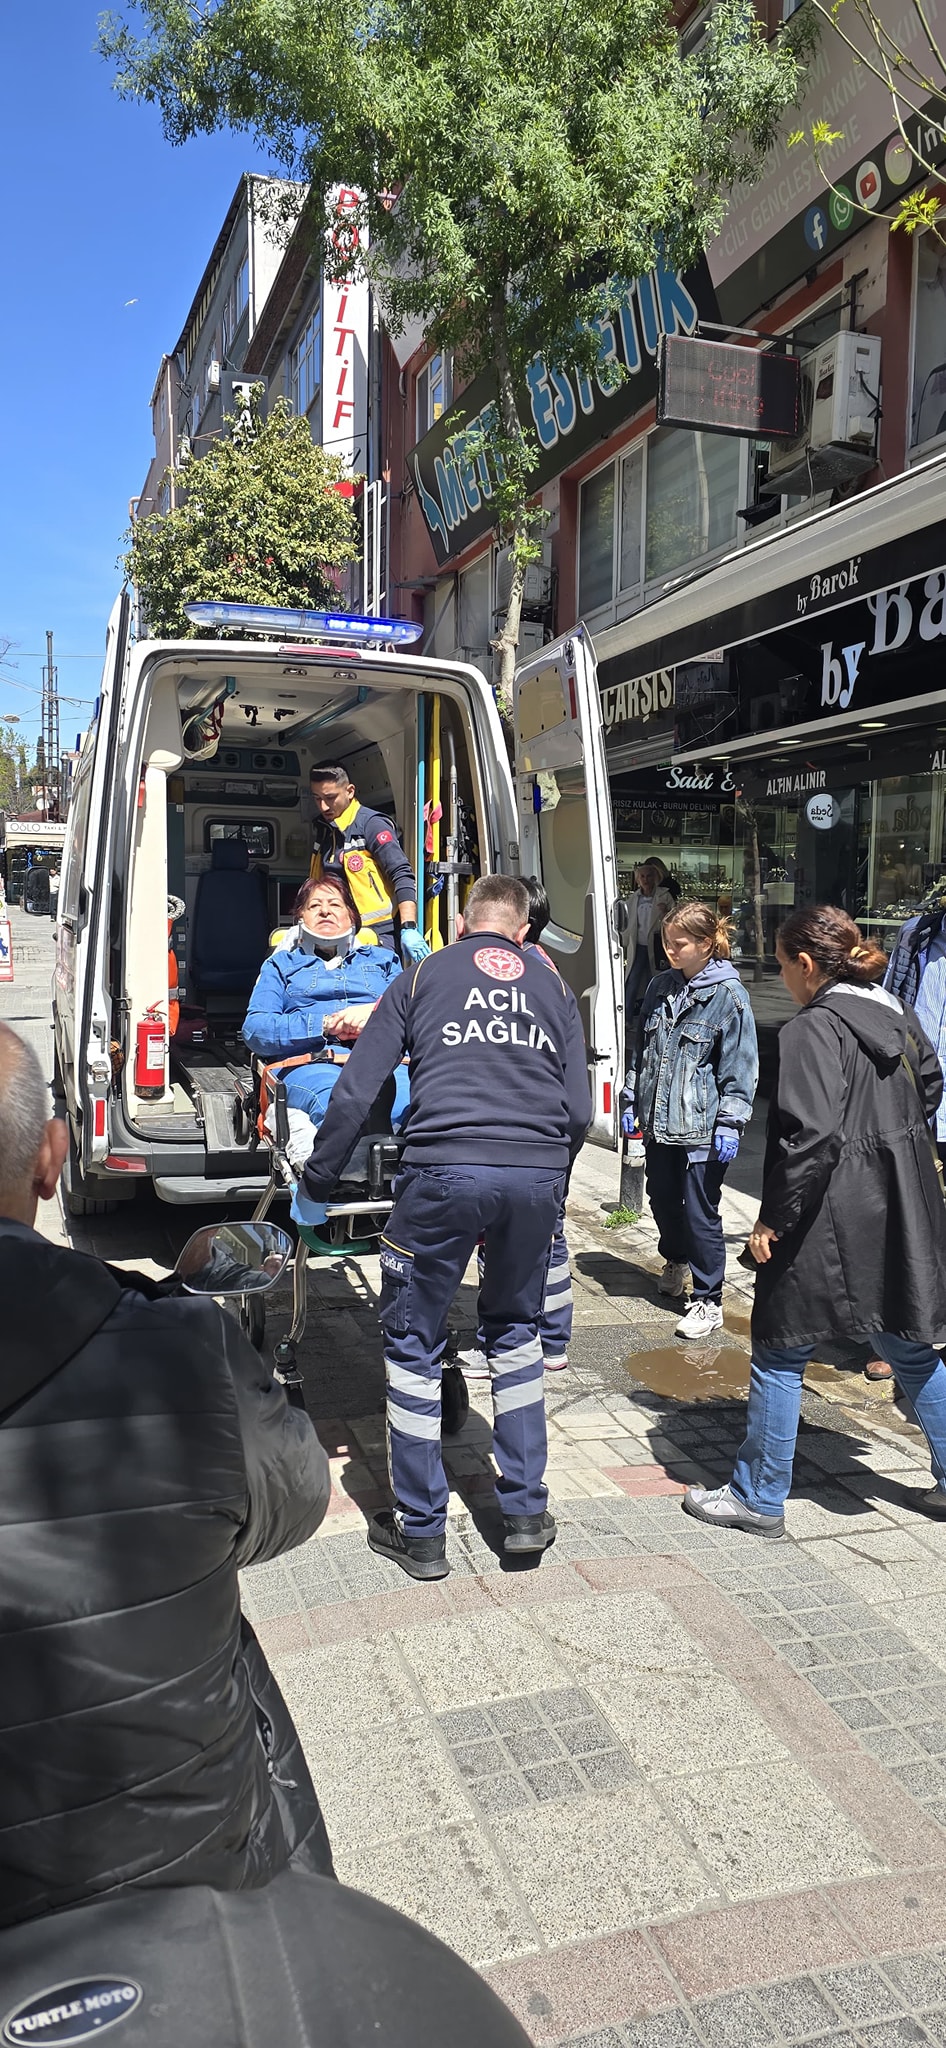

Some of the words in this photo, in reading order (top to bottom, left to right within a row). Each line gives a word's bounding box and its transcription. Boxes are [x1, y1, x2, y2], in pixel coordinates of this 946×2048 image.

[810, 560, 859, 601] Barok
[820, 641, 866, 710] by
[866, 573, 946, 656] Ba
[794, 770, 827, 793] ALINIR
[464, 986, 535, 1018] ACİL
[441, 1015, 558, 1053] SAĞLIK
[11, 2000, 83, 2035] TURTLE
[85, 1986, 136, 2013] MOTO
